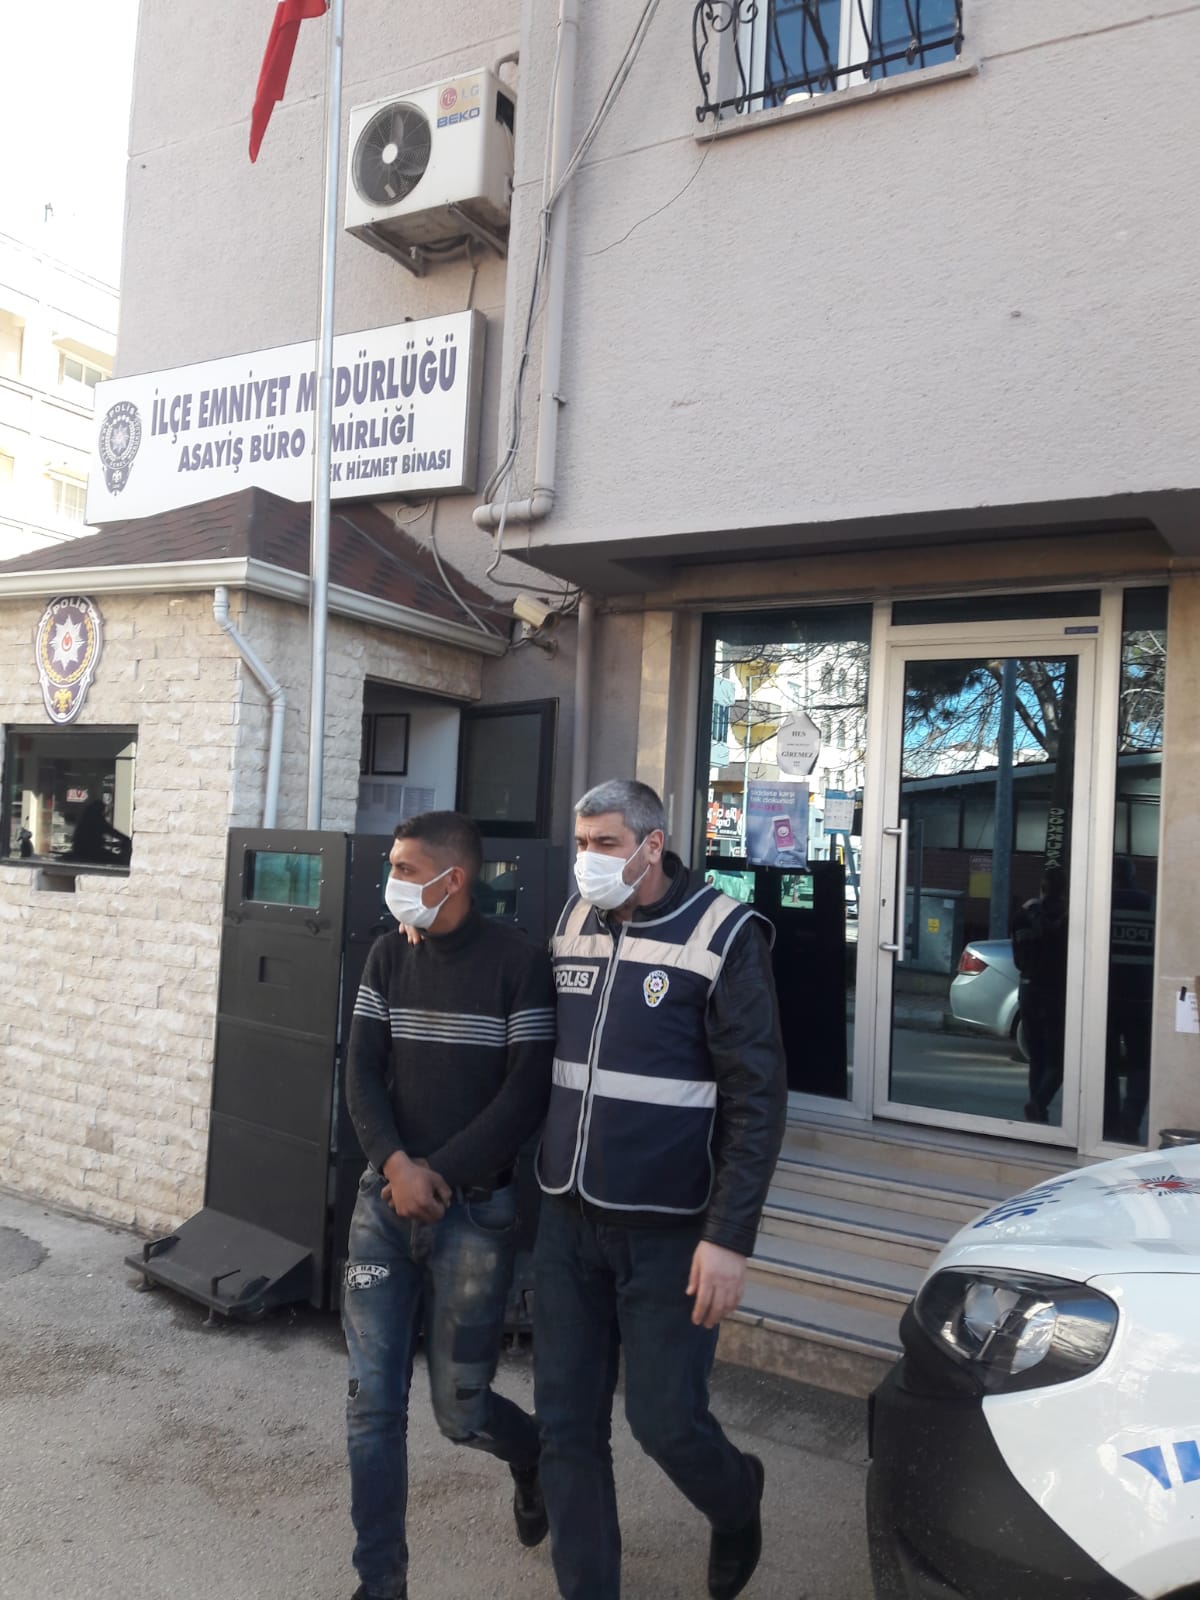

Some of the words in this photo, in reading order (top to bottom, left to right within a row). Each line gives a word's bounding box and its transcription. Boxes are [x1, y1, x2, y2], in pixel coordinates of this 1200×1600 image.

[436, 107, 480, 128] BEKO
[151, 387, 193, 444] İLÇE
[198, 369, 291, 429] EMNİYET
[296, 333, 457, 413] MDÜRLÜĞÜ
[177, 431, 244, 473] ASAYİŞ
[249, 424, 306, 464] BÜRO
[311, 403, 415, 455] MİRLİĞİ
[345, 455, 398, 481] HİZMET
[401, 448, 452, 474] BİNASI
